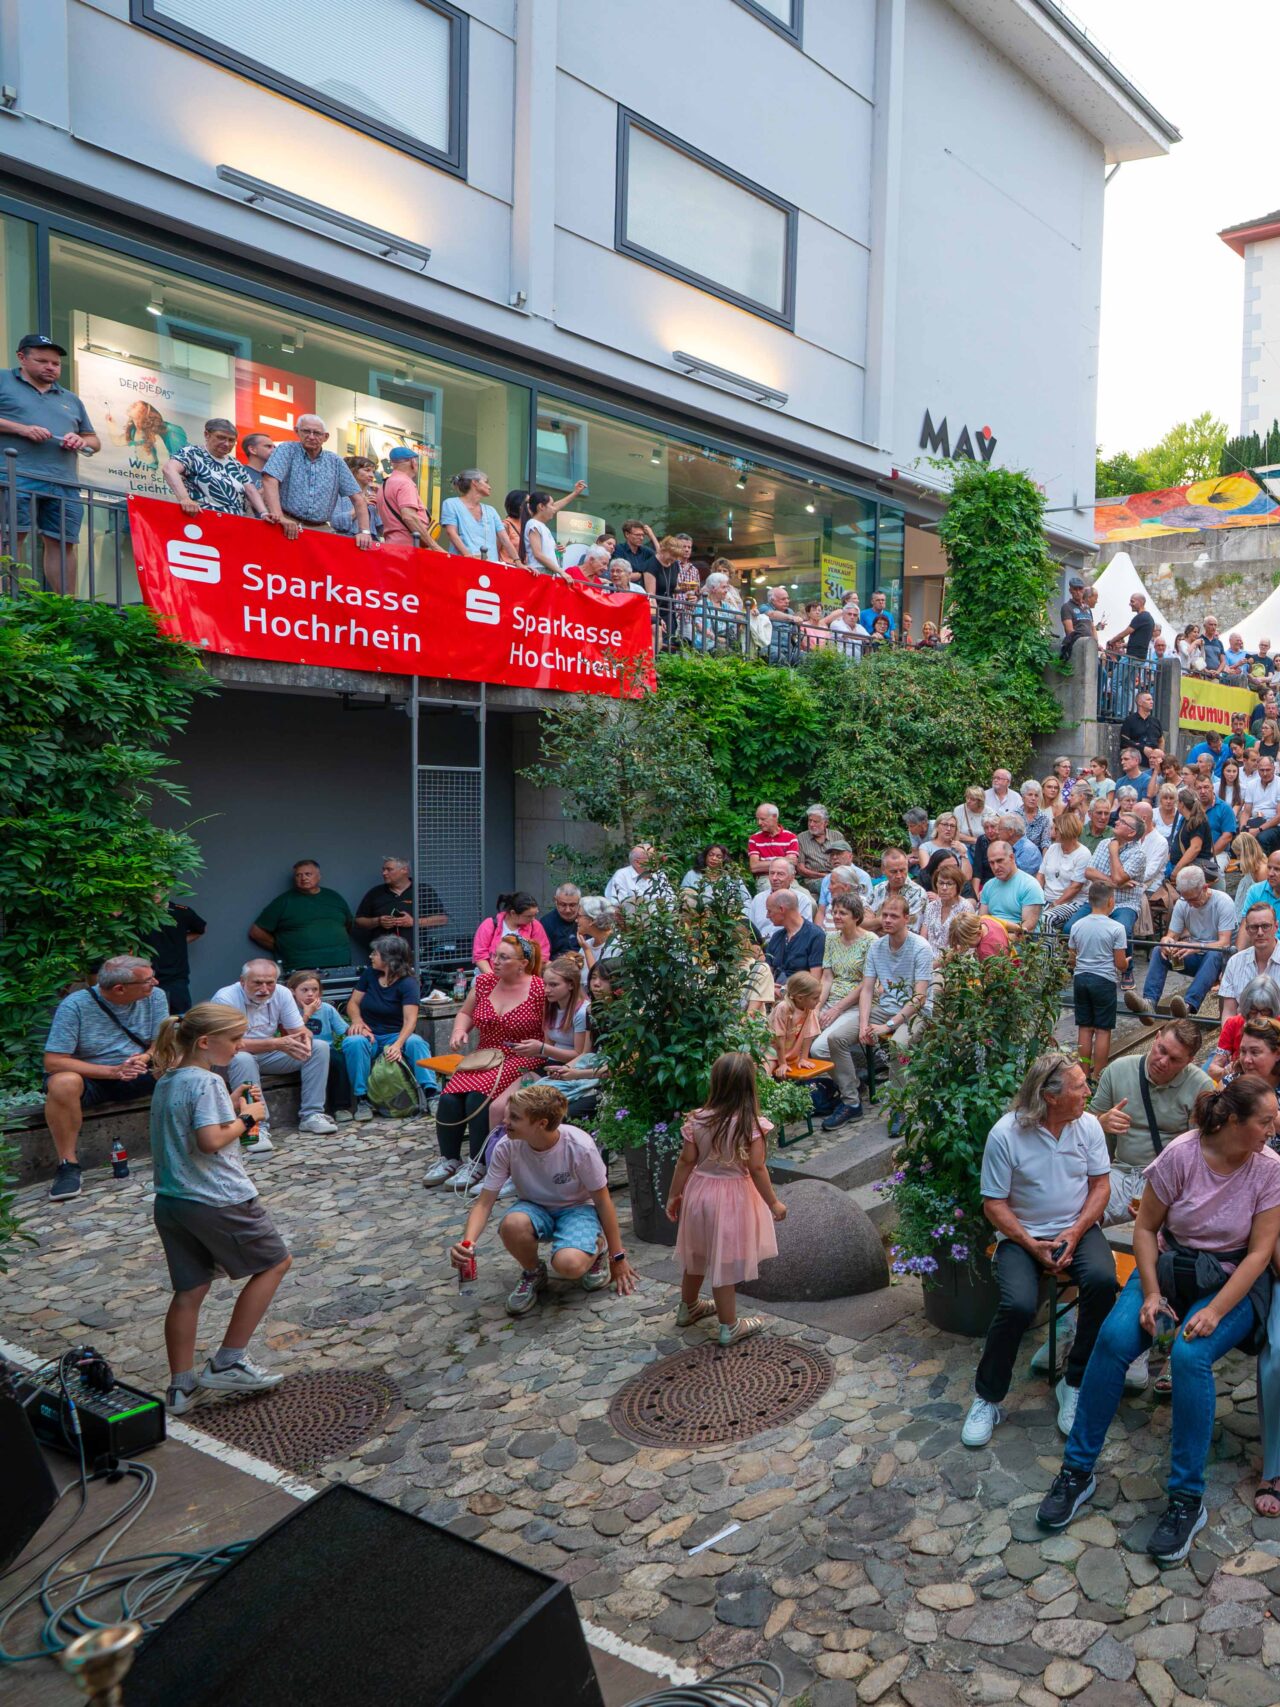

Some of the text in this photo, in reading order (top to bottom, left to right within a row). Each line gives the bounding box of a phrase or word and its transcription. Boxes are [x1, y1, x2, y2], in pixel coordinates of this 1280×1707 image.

[259, 377, 294, 446] LE
[108, 468, 147, 480] machen
[129, 457, 153, 471] Wir
[242, 563, 420, 613] Sparkasse
[243, 605, 421, 652] Hochrhein
[512, 606, 623, 647] Sparkasse
[509, 641, 624, 679] Hochrhein
